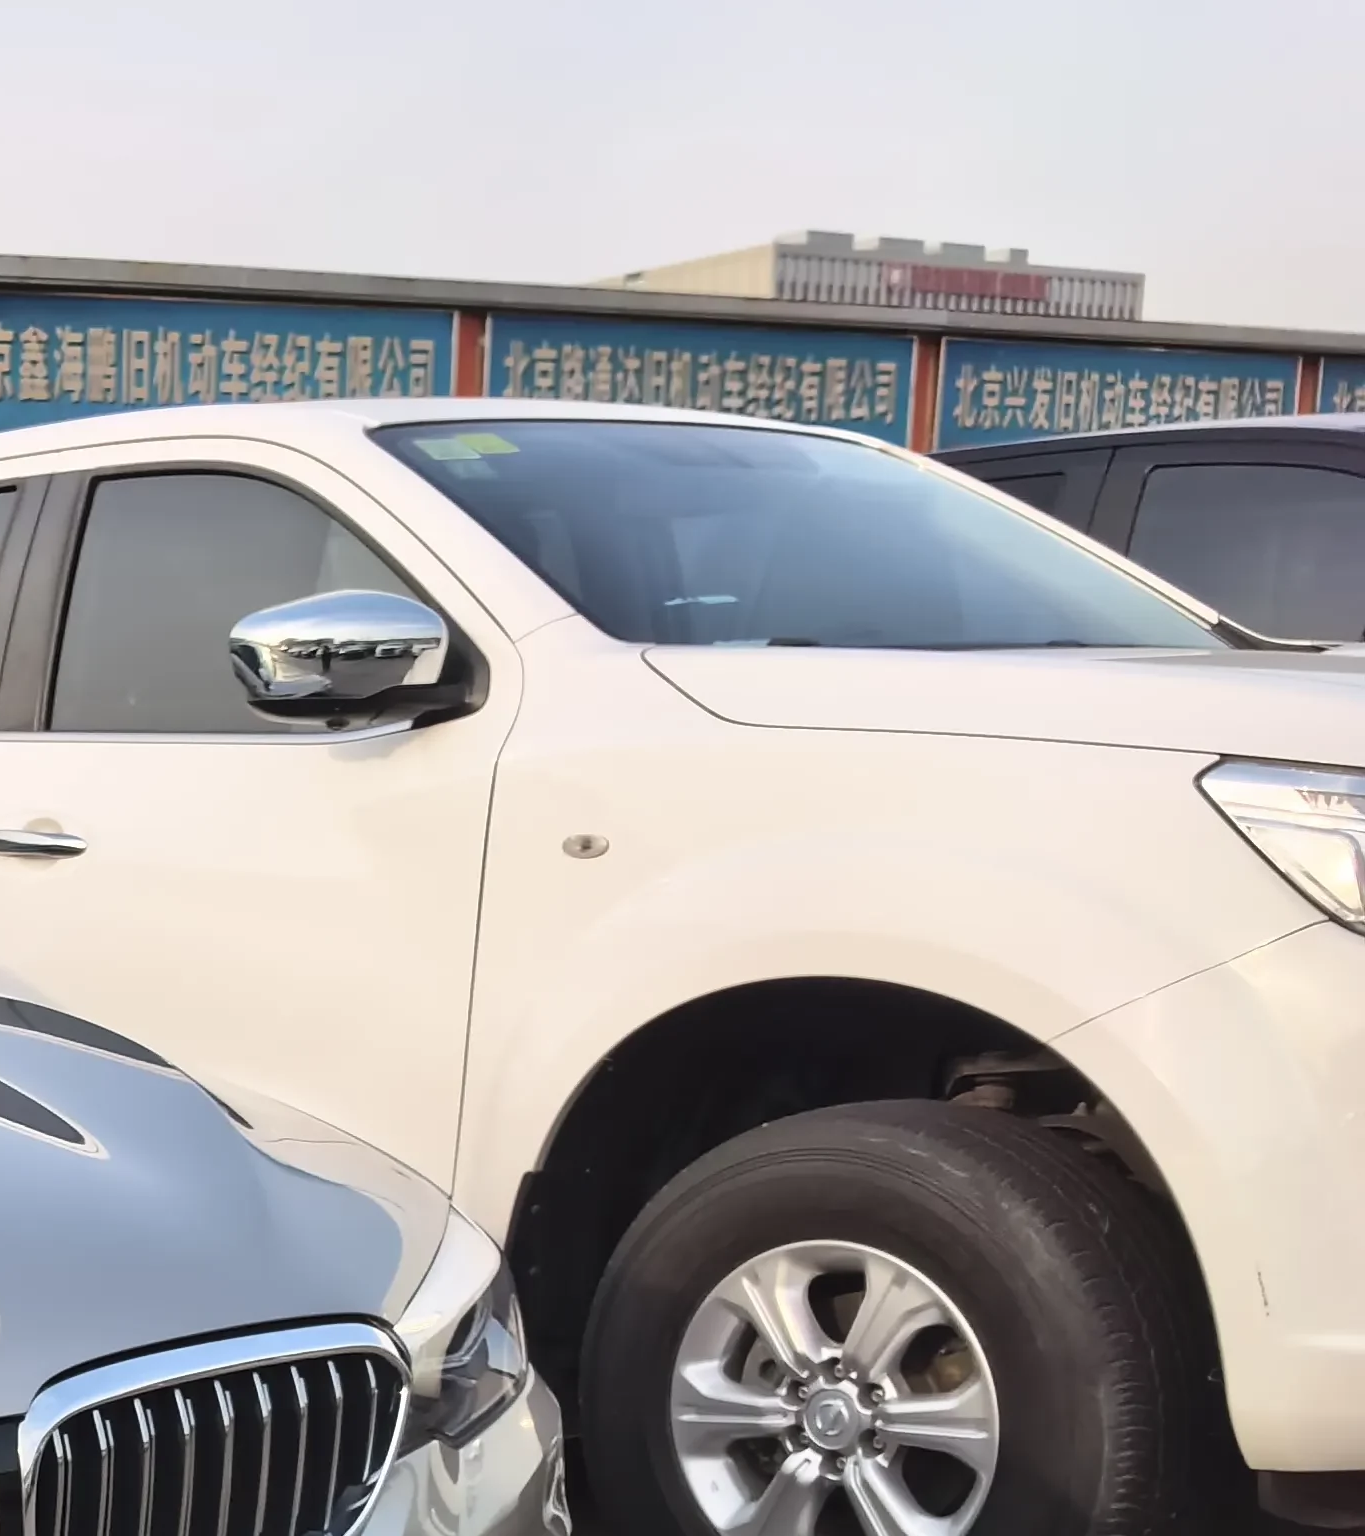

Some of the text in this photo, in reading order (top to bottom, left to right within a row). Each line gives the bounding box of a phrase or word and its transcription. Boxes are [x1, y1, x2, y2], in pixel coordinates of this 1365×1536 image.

[953, 363, 1284, 430] 北京兴发旧机动车经纪有限公司
